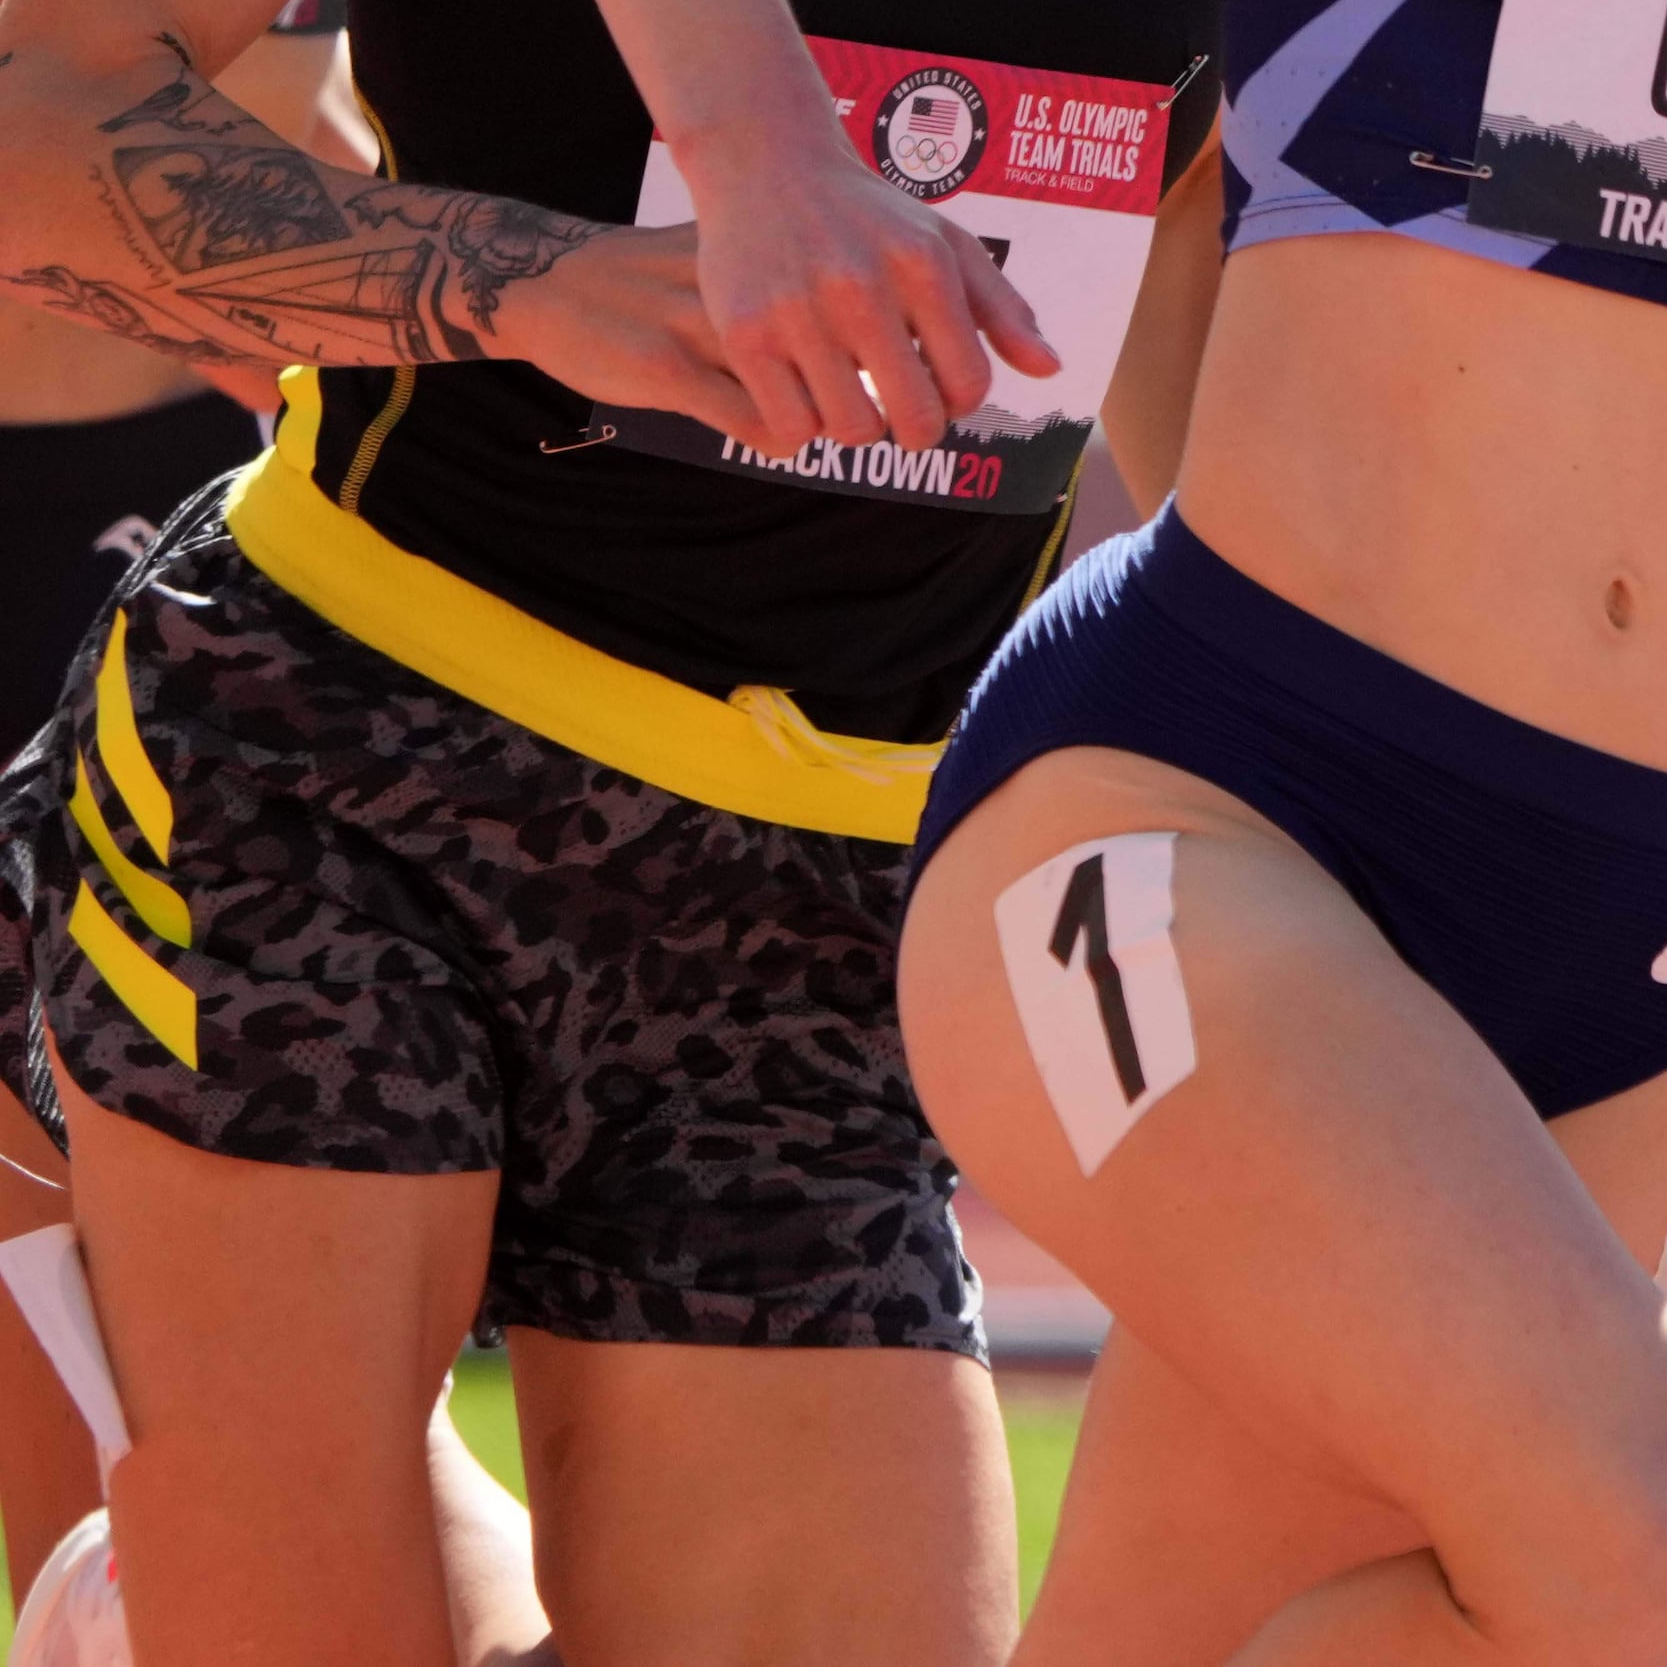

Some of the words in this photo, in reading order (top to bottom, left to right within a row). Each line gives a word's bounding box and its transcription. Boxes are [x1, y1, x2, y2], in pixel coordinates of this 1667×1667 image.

[892, 70, 940, 100] UNITED
[1014, 93, 1052, 132] U.S.
[1059, 99, 1148, 144] OLYMPIC
[880, 157, 926, 197] OLYMPIC
[932, 169, 965, 195] TEAM
[1008, 130, 1066, 172] TEAM
[1069, 138, 1139, 182] TRIALS
[1004, 167, 1047, 186] TRACK
[1047, 175, 1057, 188] &
[1059, 176, 1095, 193] FIELD
[1048, 852, 1147, 1108] 1
